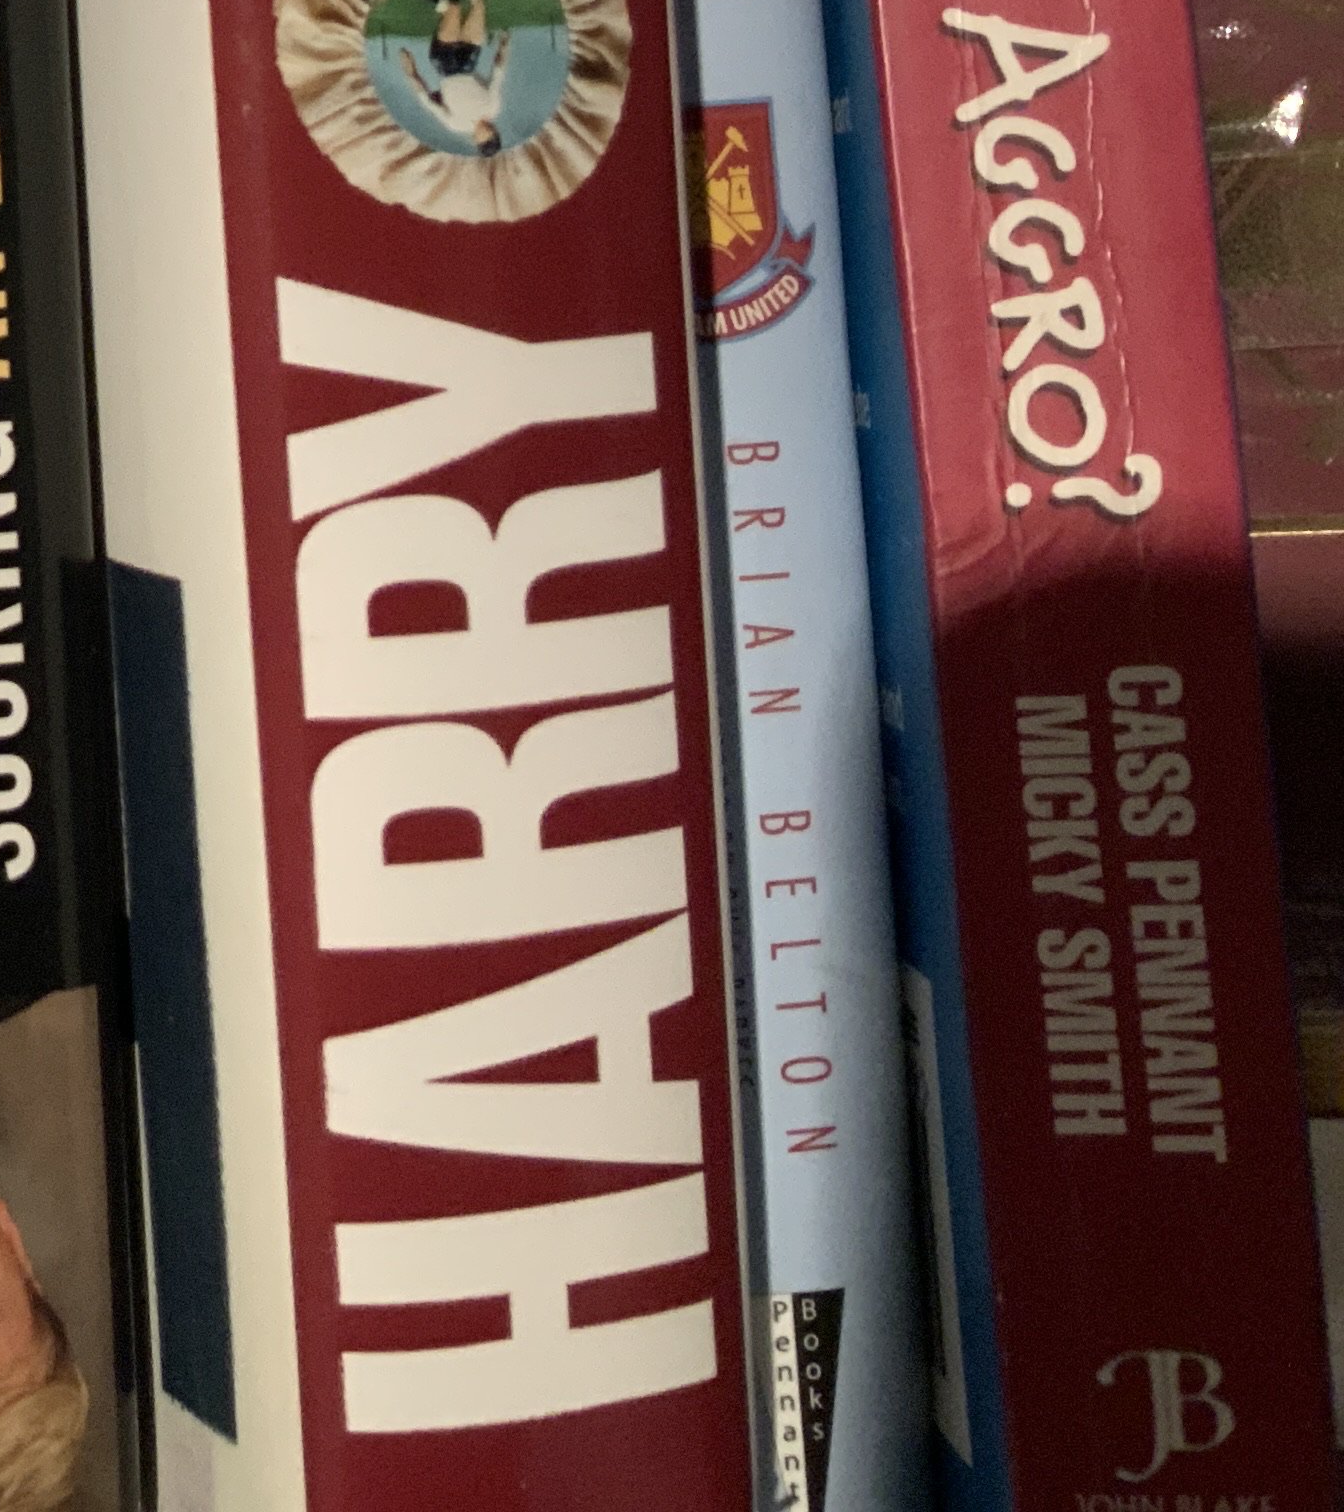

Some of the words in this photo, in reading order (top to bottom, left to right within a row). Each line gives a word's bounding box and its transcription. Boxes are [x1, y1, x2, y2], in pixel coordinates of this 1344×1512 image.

[730, 274, 800, 331] UNITED
[941, 6, 1165, 518] AGGRO?
[726, 440, 801, 717] BRIAN
[274, 274, 717, 1435] HARRY
[1015, 694, 1106, 904] MICKY
[1107, 663, 1194, 839] CASS
[759, 810, 839, 1156] BELTON
[1036, 926, 1128, 1138] SMITH
[1124, 857, 1229, 1164] PENNANT
[772, 1300, 800, 1503] Pennant
[801, 1297, 826, 1441] Books
